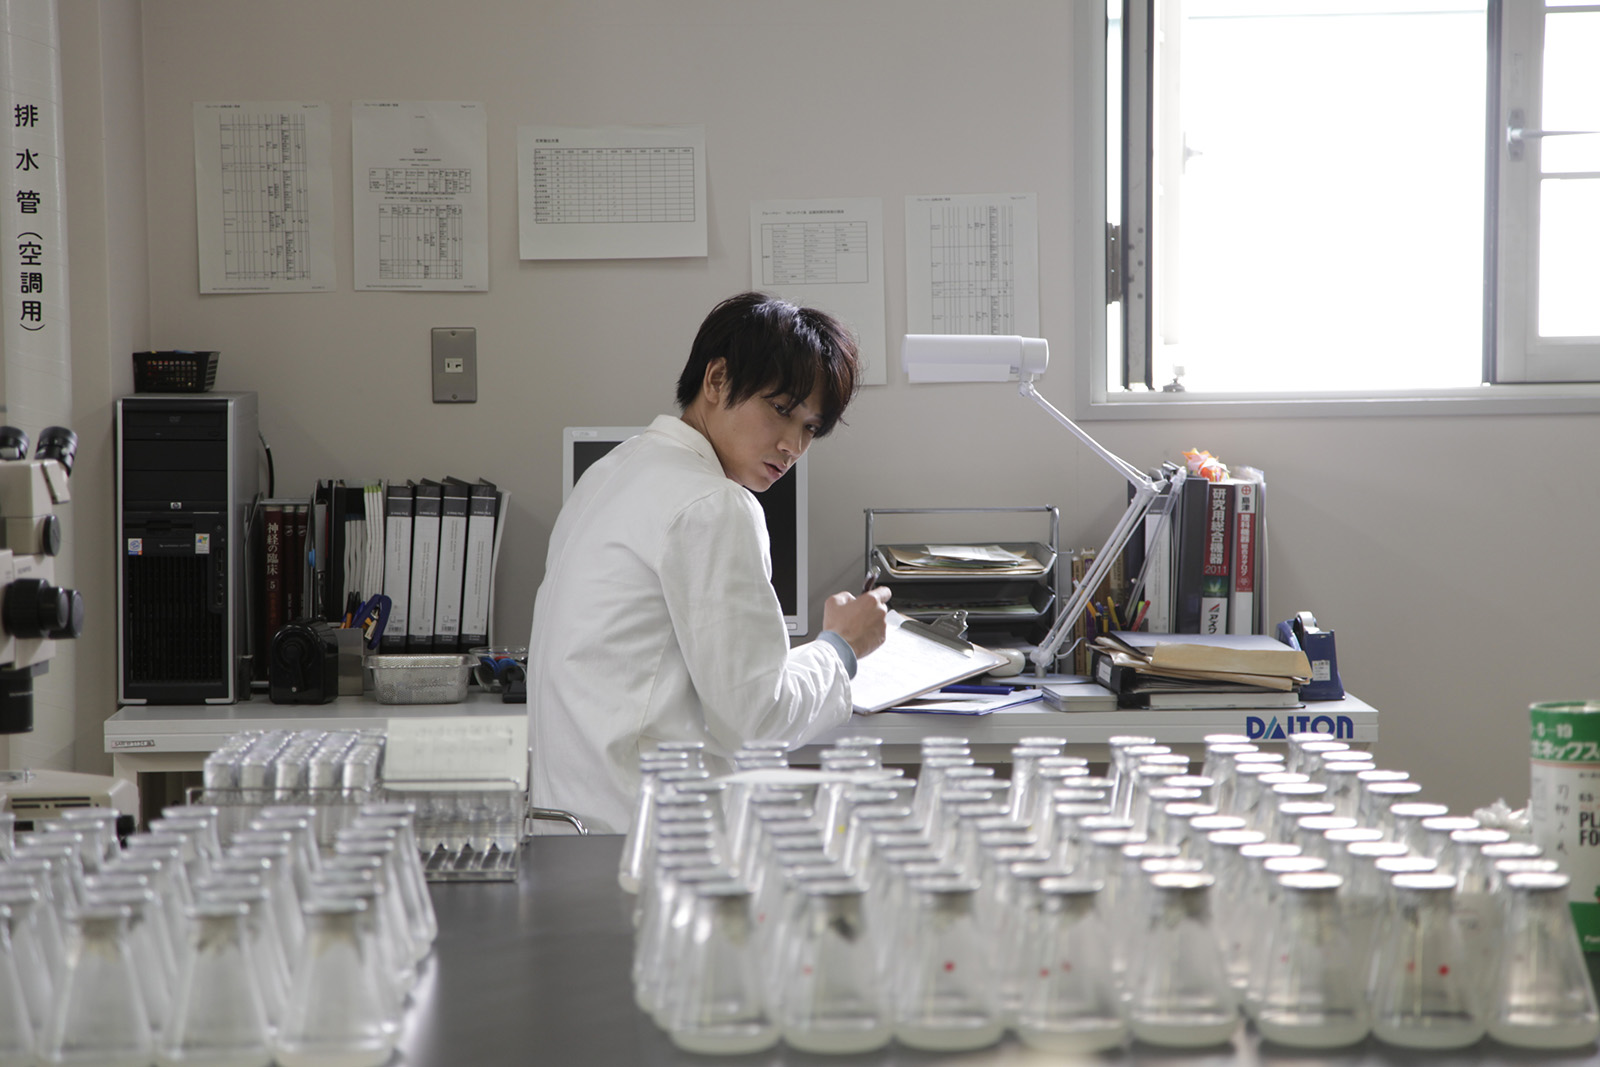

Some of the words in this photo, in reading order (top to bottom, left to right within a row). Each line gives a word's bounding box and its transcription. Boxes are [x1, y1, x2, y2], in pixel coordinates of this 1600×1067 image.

[1208, 487, 1227, 565] 研究用総合機器
[266, 521, 280, 576] 神経の臨床
[1204, 565, 1228, 575] 2011
[1246, 715, 1354, 740] DALTON
[1579, 811, 1600, 829] PL
[1579, 829, 1600, 847] FO
